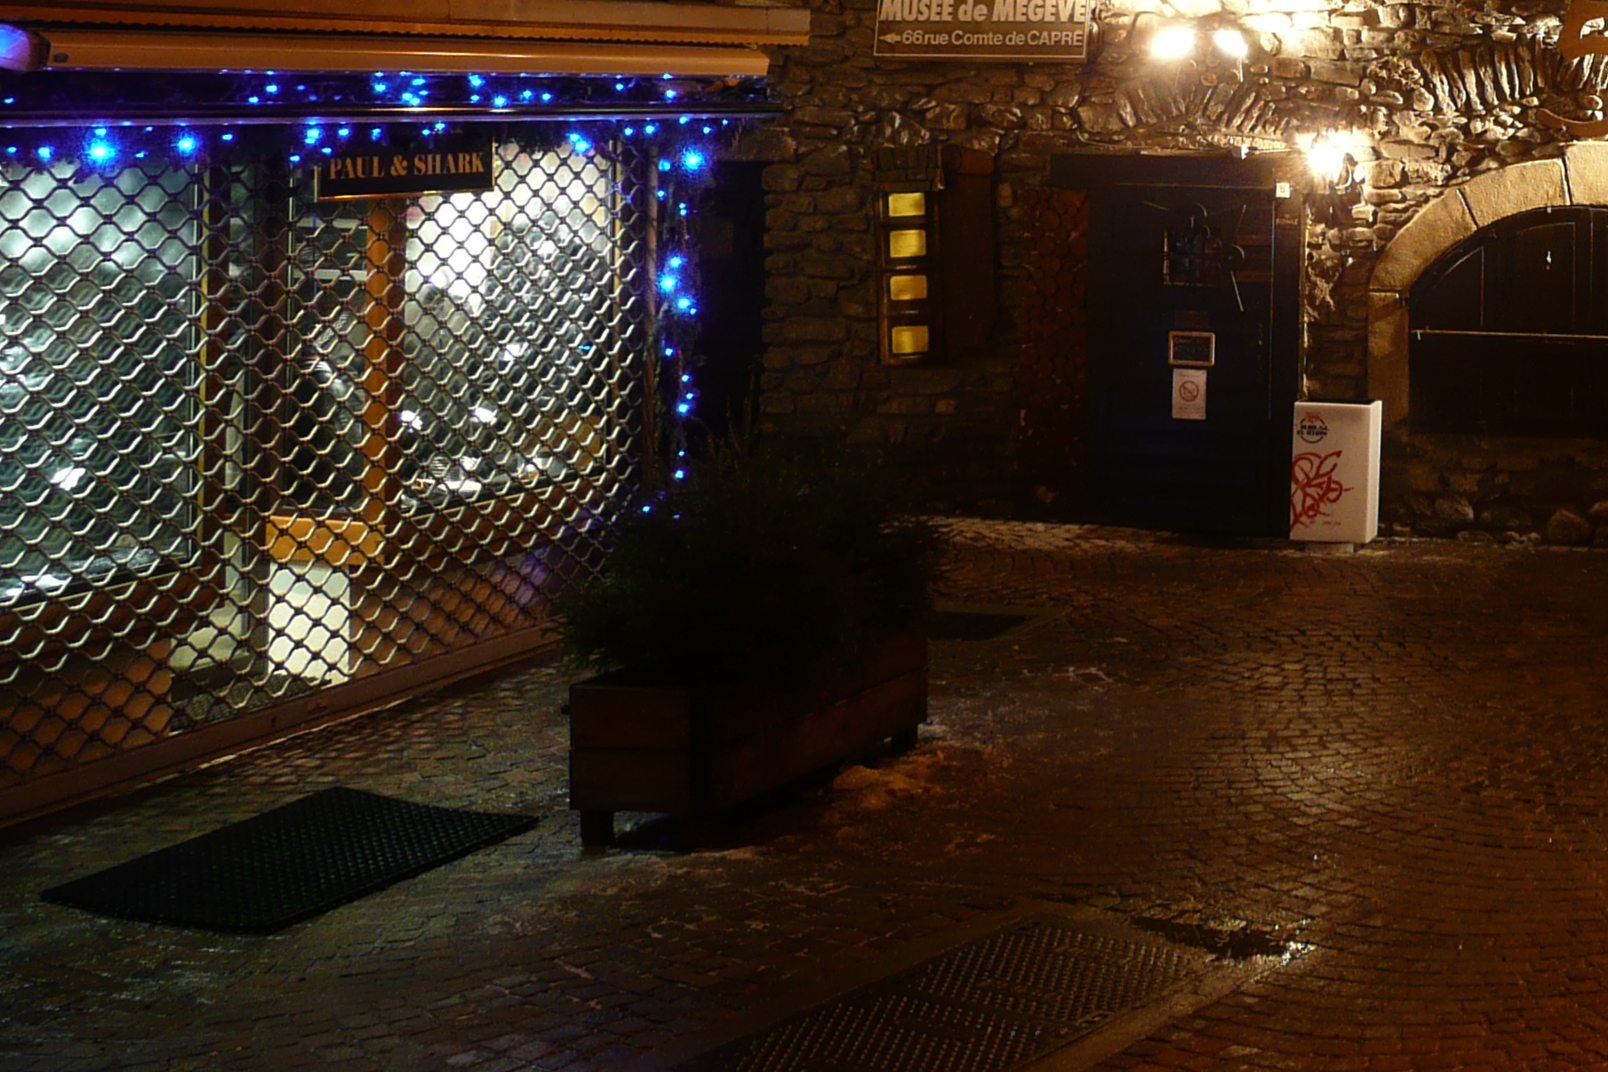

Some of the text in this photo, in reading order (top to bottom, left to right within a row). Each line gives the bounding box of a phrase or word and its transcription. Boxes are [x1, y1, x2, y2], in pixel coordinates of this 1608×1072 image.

[957, 0, 988, 22] de
[951, 30, 1003, 45] Comte
[1005, 31, 1025, 45] de
[329, 152, 485, 179] PAUL & SHARK
